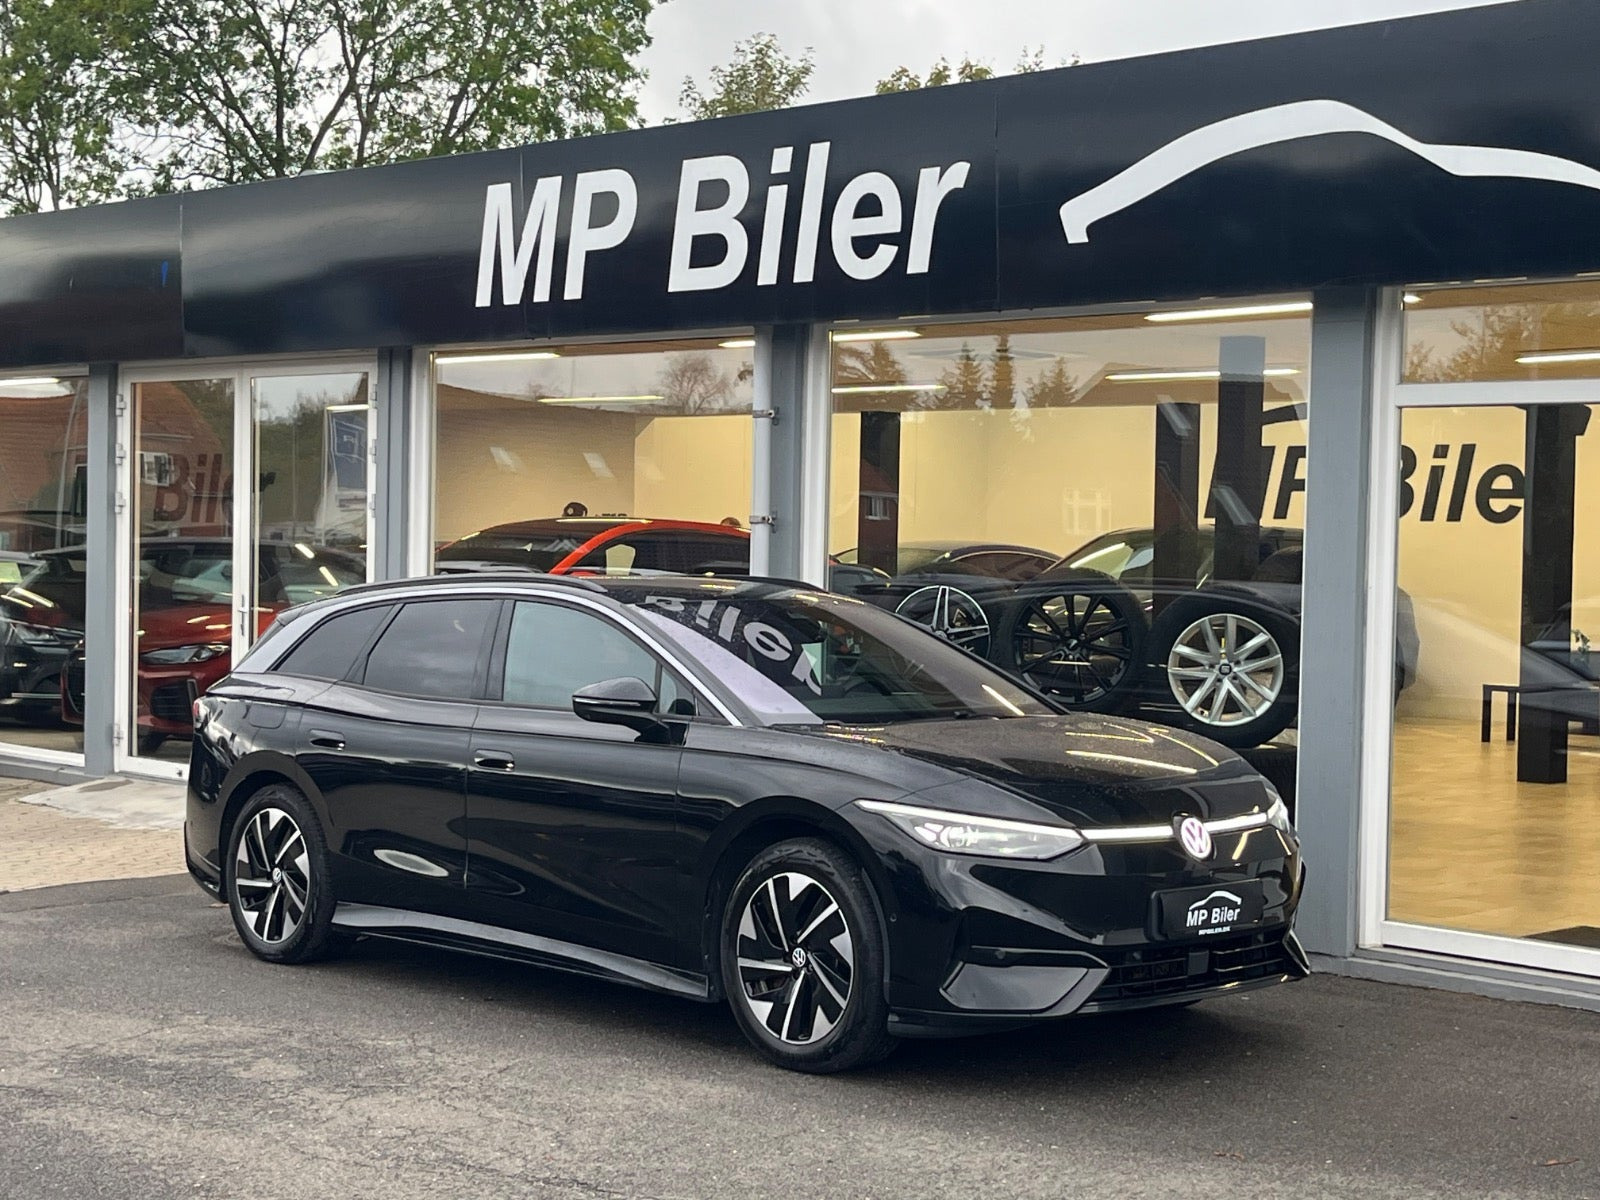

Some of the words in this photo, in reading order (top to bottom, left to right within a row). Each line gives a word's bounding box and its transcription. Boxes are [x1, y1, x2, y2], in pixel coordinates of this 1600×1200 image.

[475, 168, 638, 308] MP
[667, 141, 971, 293] Biler
[1186, 909, 1208, 928] MP
[1211, 906, 1241, 924] Biler
